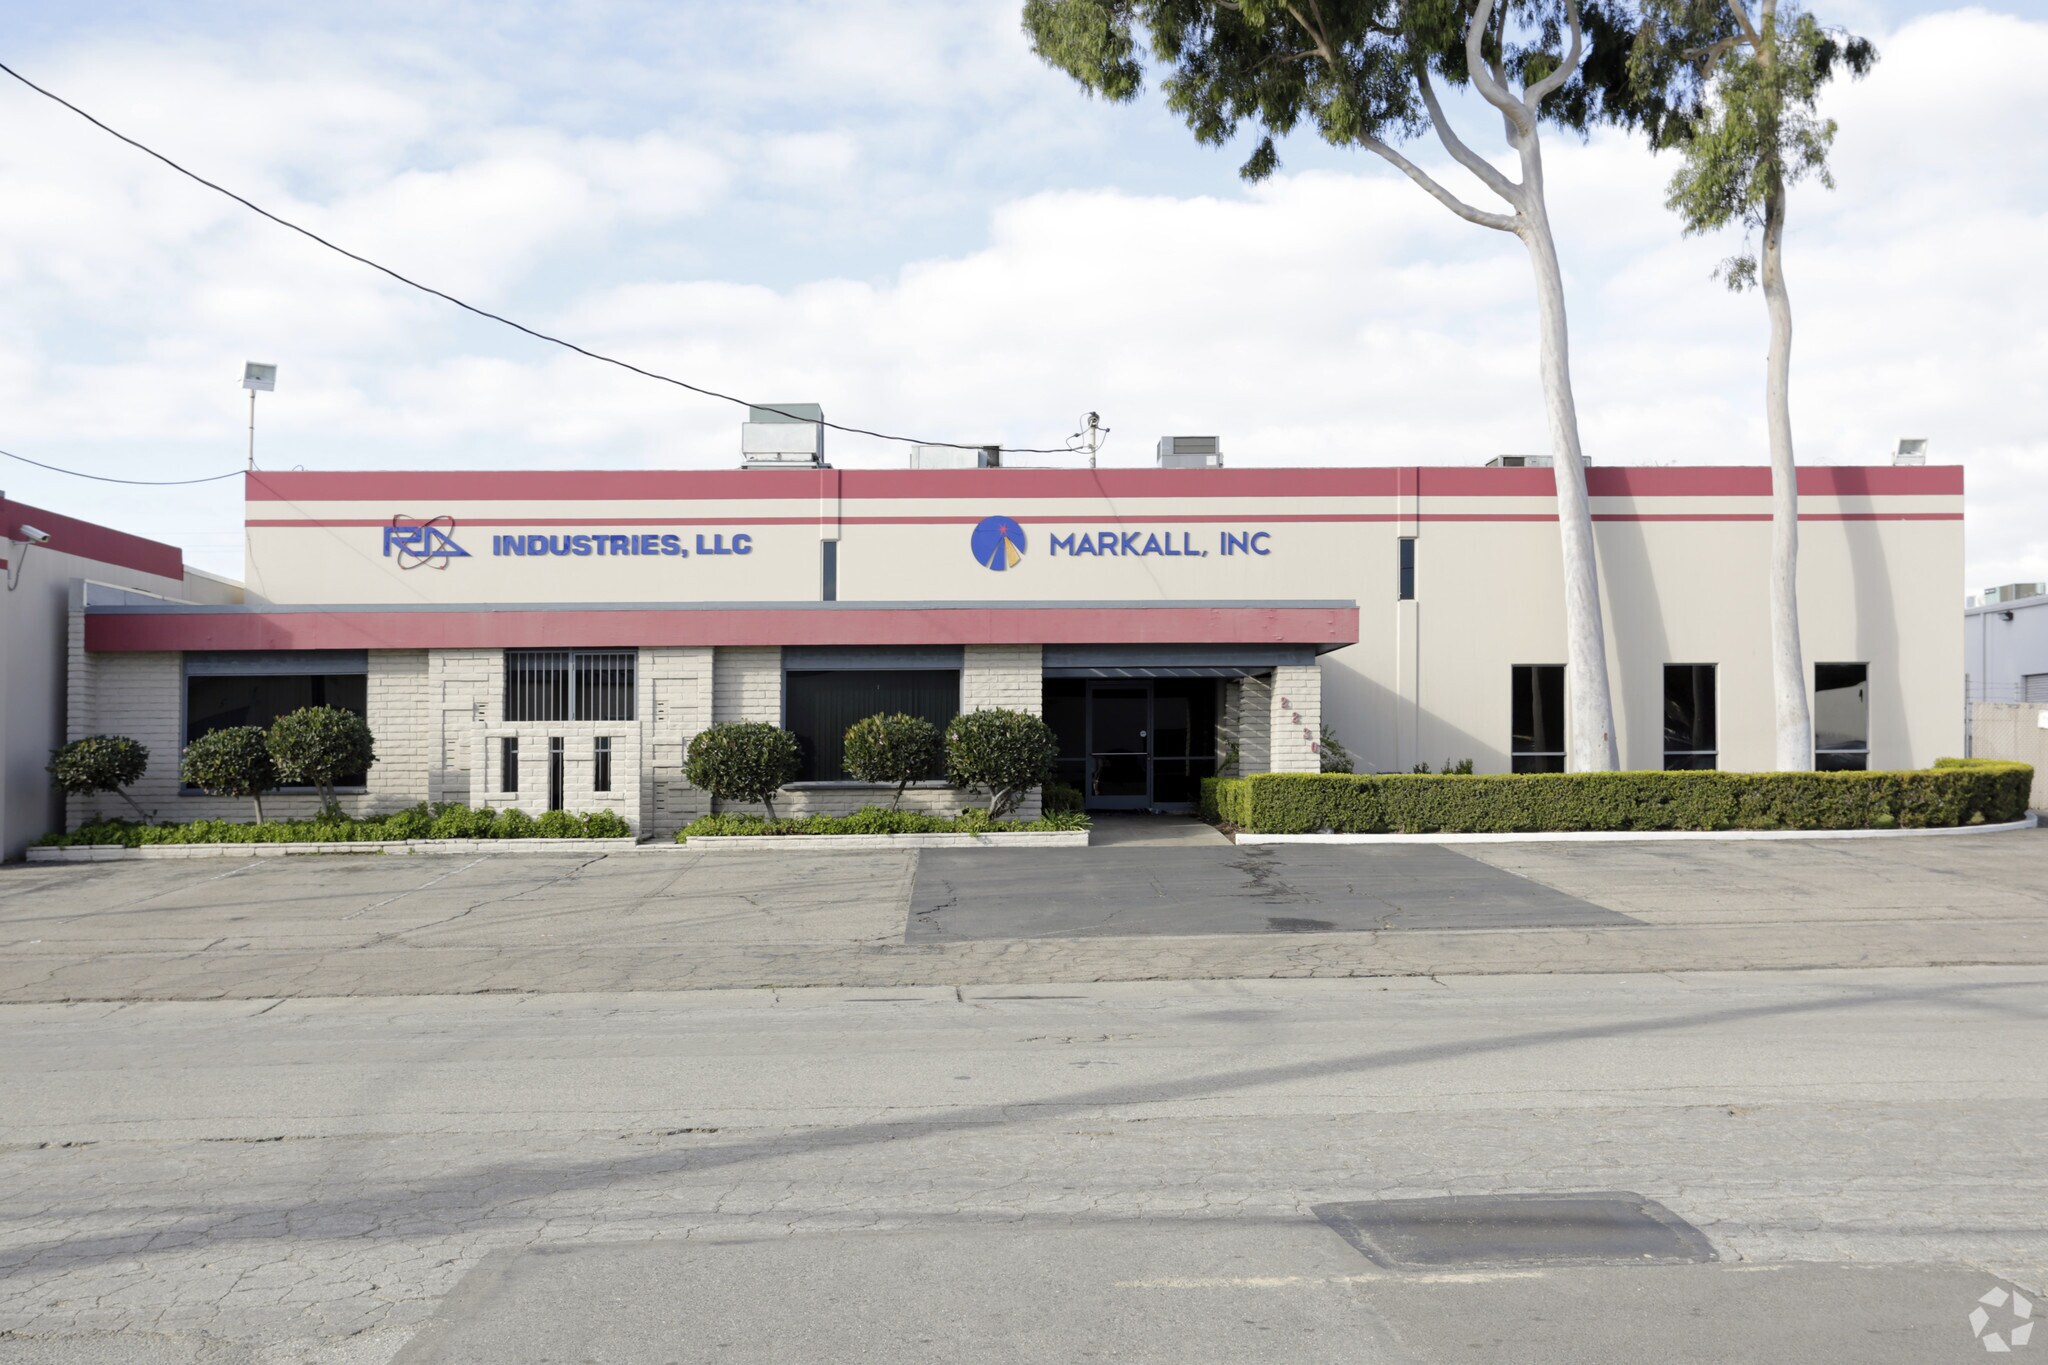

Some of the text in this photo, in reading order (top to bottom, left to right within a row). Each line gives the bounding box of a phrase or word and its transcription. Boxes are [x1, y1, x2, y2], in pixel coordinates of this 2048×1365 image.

[493, 534, 689, 558] INDUSTRIES,
[695, 533, 753, 555] LLC
[1050, 531, 1271, 557] MARKALL, INC
